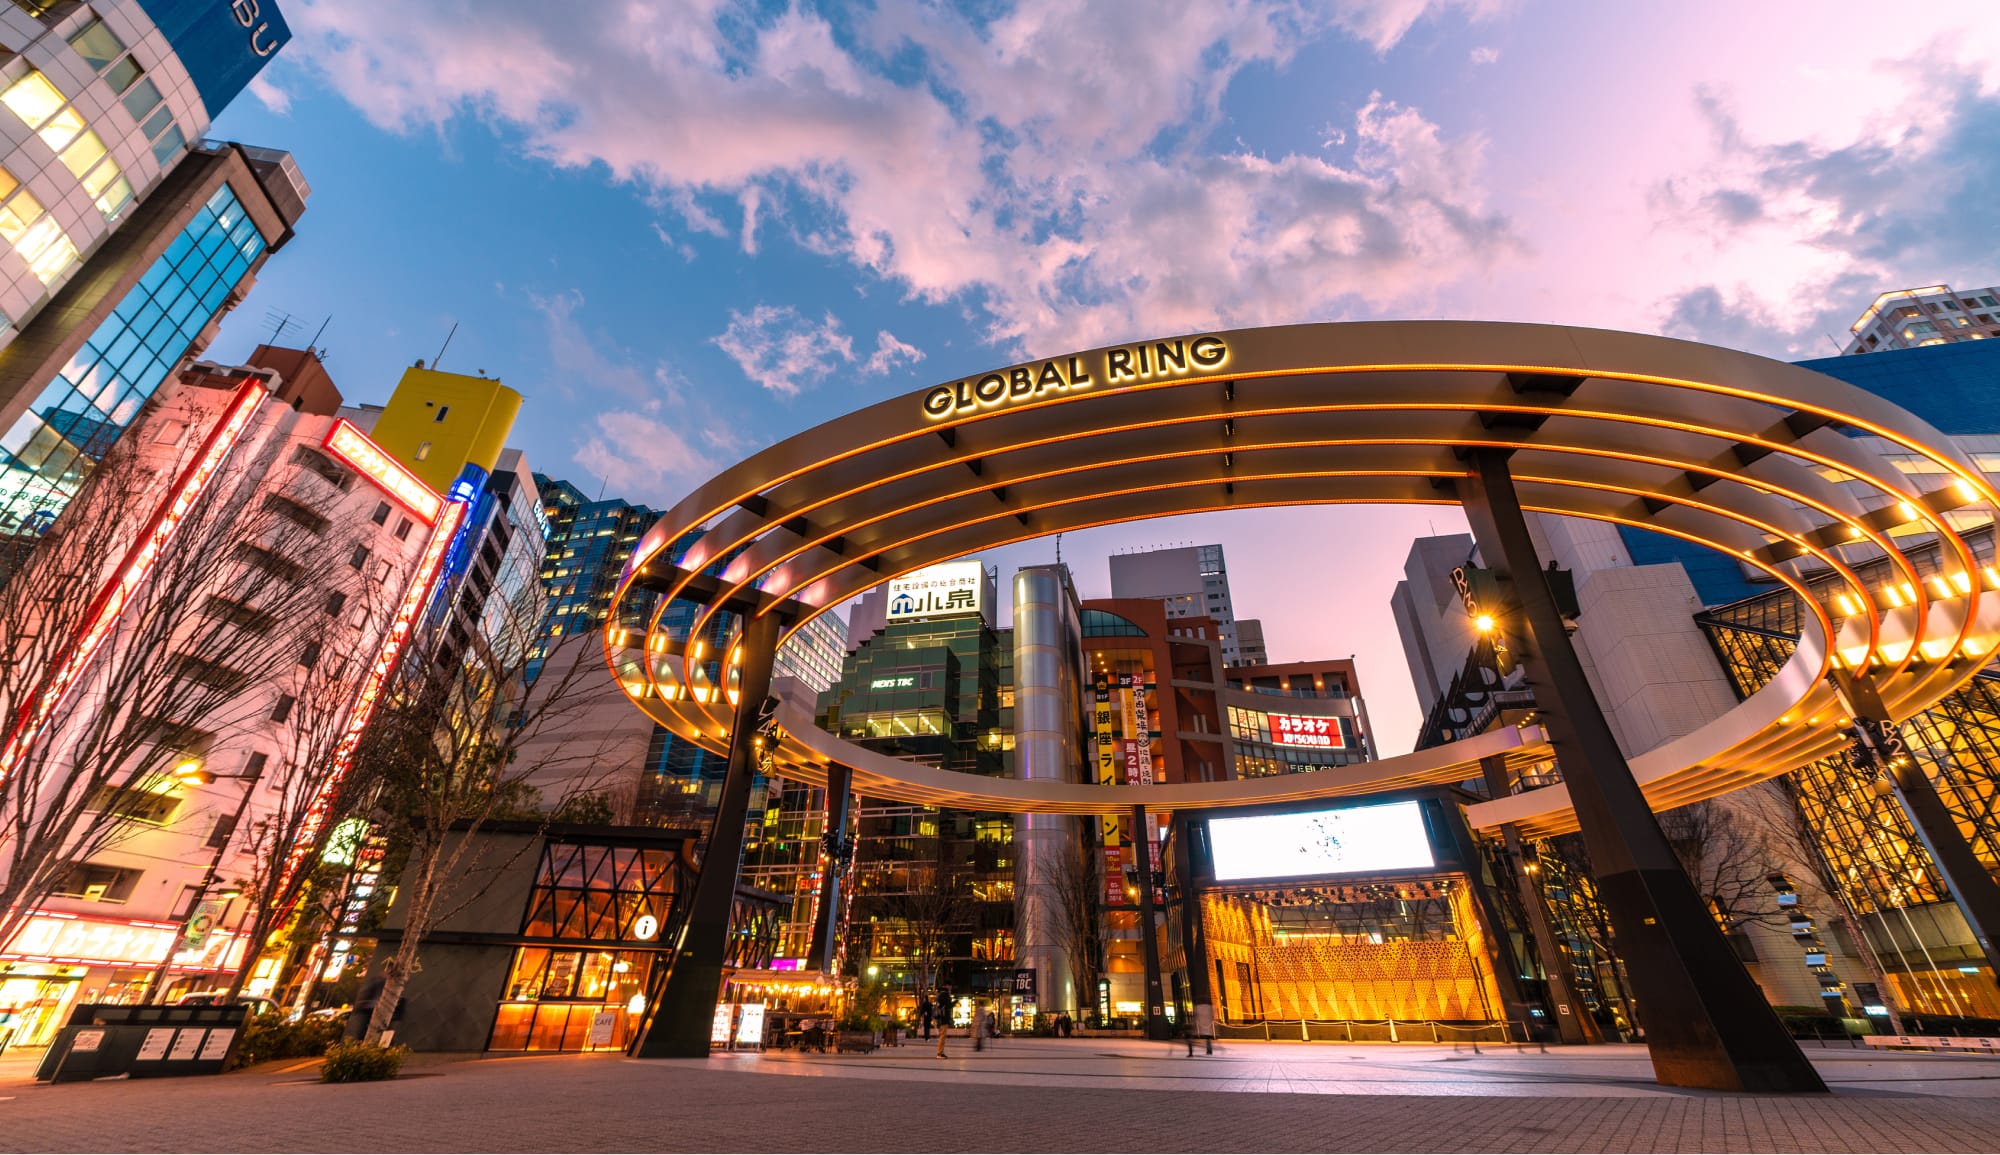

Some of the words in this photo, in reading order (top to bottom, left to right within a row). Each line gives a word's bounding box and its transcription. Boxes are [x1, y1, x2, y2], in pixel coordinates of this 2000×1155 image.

[923, 356, 1090, 416] GLOBAL
[1107, 335, 1228, 380] RING
[914, 588, 976, 613] 小泉
[1279, 717, 1330, 733] カラオケ
[1016, 978, 1032, 990] TBC
